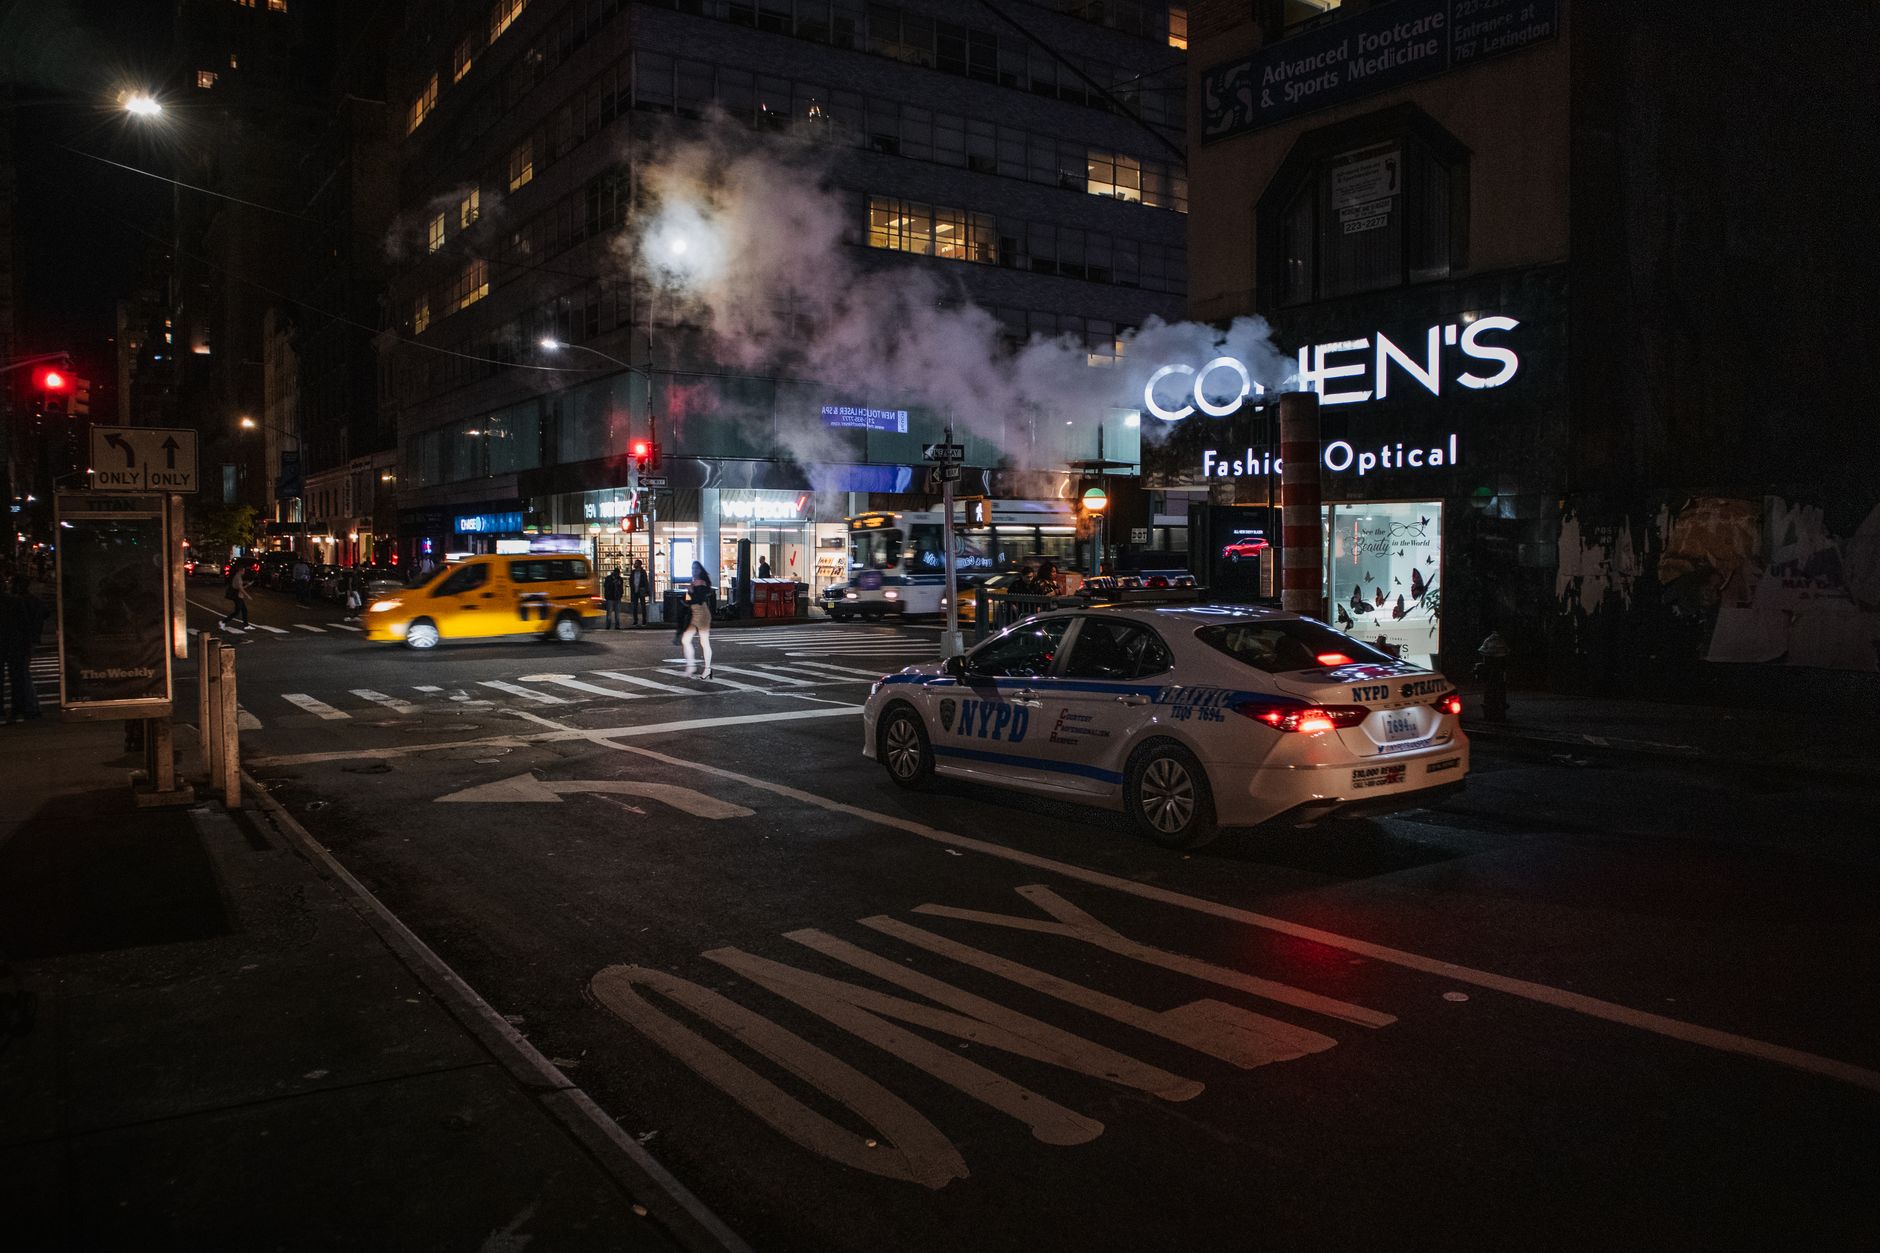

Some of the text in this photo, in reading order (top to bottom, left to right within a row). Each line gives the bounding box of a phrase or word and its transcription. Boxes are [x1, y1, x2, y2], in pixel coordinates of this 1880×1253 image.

[1454, 3, 1536, 42] Entrance at
[1262, 10, 1445, 87] Advanced Footcare
[1483, 22, 1550, 53] Lexington
[1260, 37, 1438, 109] & Sports Medicine
[1345, 216, 1386, 232] 223-2277
[1204, 434, 1457, 477] Fashio Optical
[99, 471, 190, 485] ONLY ONLY
[1361, 527, 1386, 536] See the
[1350, 535, 1394, 558] Beauty
[80, 667, 155, 680] The Weekly
[1156, 687, 1233, 707] TRAFFIC
[1352, 679, 1448, 702] NYPD TRAFFIC
[957, 699, 1029, 743] NYPD
[1387, 718, 1409, 735] 7694
[589, 884, 1398, 1190] ONLY
